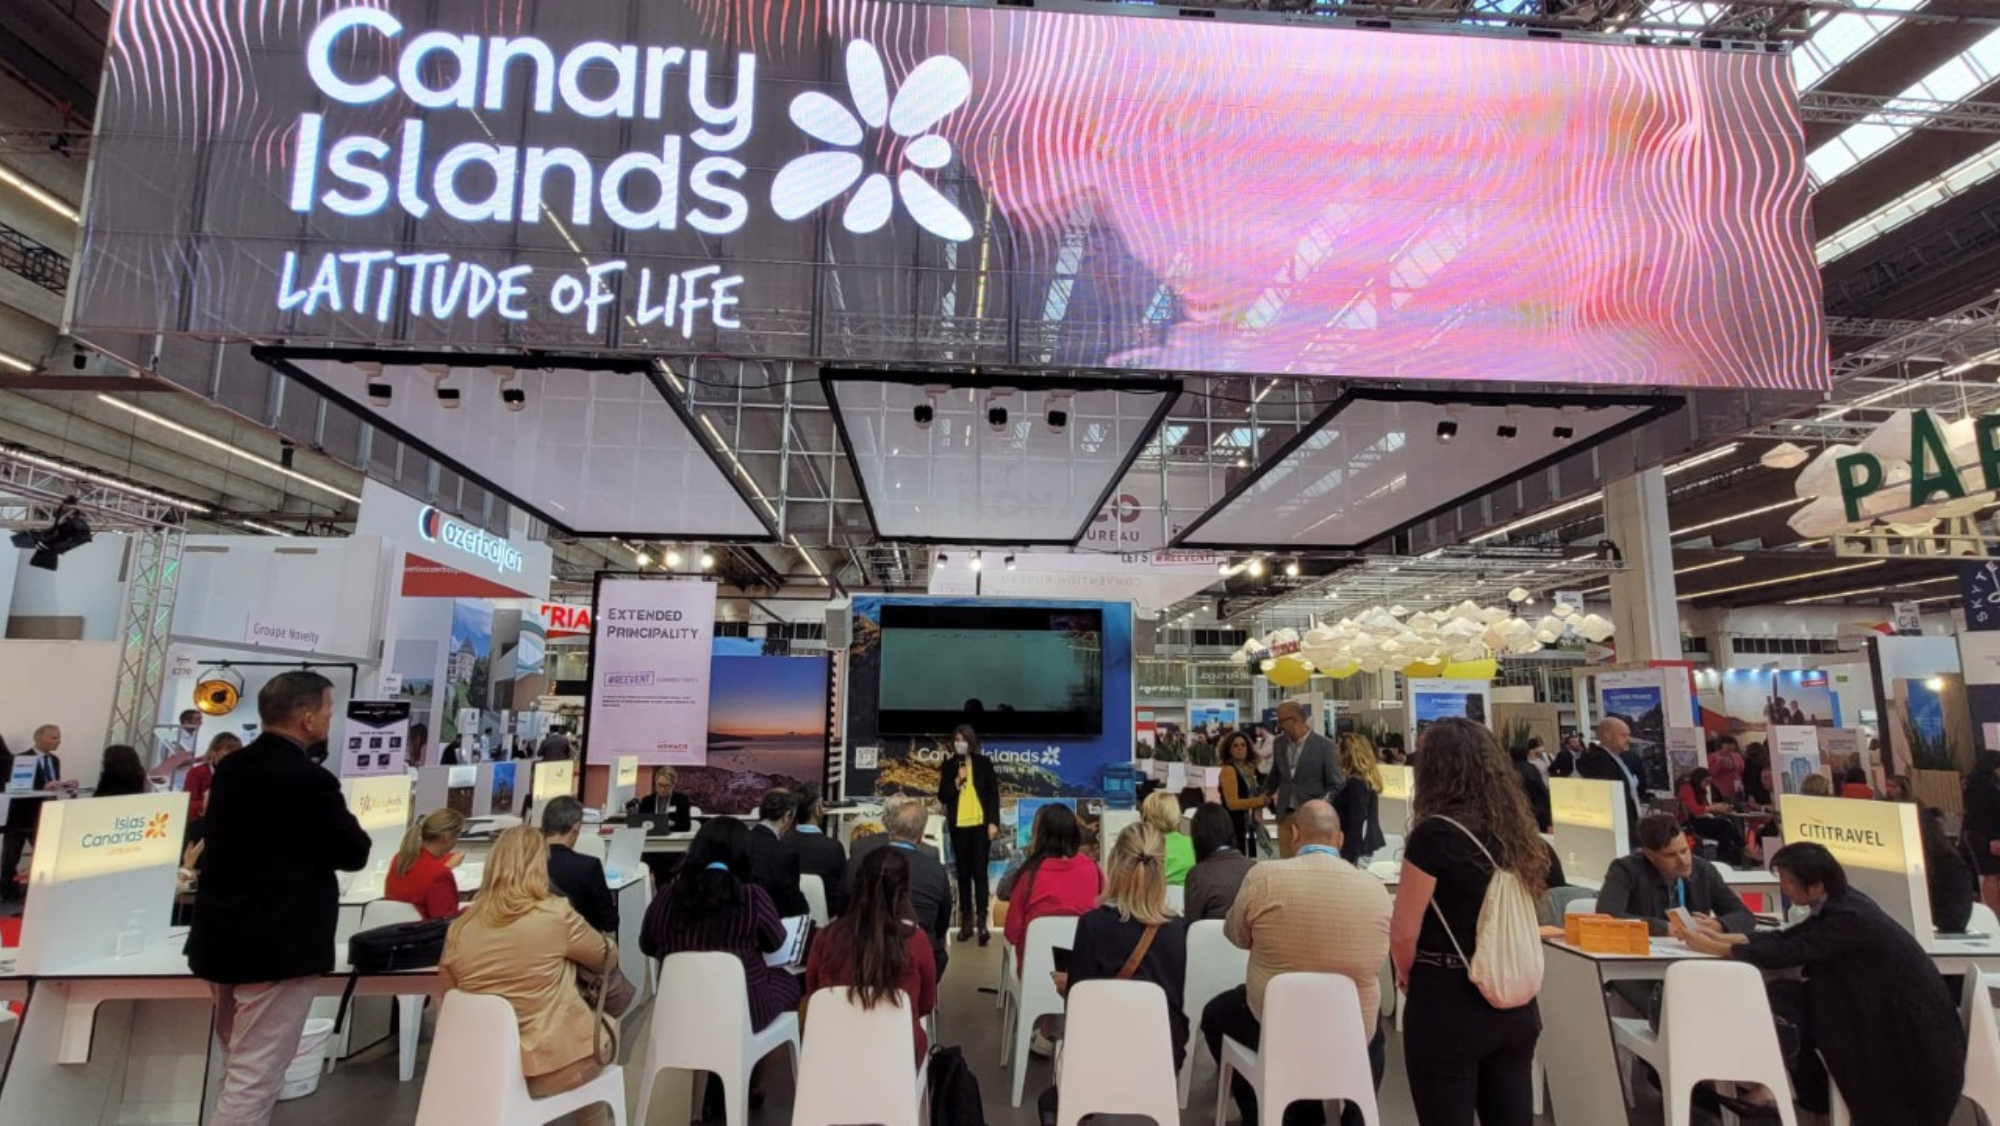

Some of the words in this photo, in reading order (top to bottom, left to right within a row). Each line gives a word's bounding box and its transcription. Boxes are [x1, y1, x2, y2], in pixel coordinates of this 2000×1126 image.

[306, 6, 756, 151] Canary
[291, 112, 749, 235] Islands
[278, 250, 533, 322] LATITUDE
[550, 261, 627, 334] OF
[637, 266, 744, 339] LIFE
[442, 520, 524, 573] azerbaijan
[1087, 529, 1140, 542] UREAU
[608, 608, 682, 622] EXTENDED
[253, 621, 286, 640] Groupe
[288, 628, 320, 645] Novelty
[607, 626, 700, 640] PRINCIPALITY
[917, 746, 953, 762] Can
[114, 816, 146, 831] Islas
[81, 829, 145, 849] Canarias
[1799, 823, 1886, 848] CITITRAVEL
